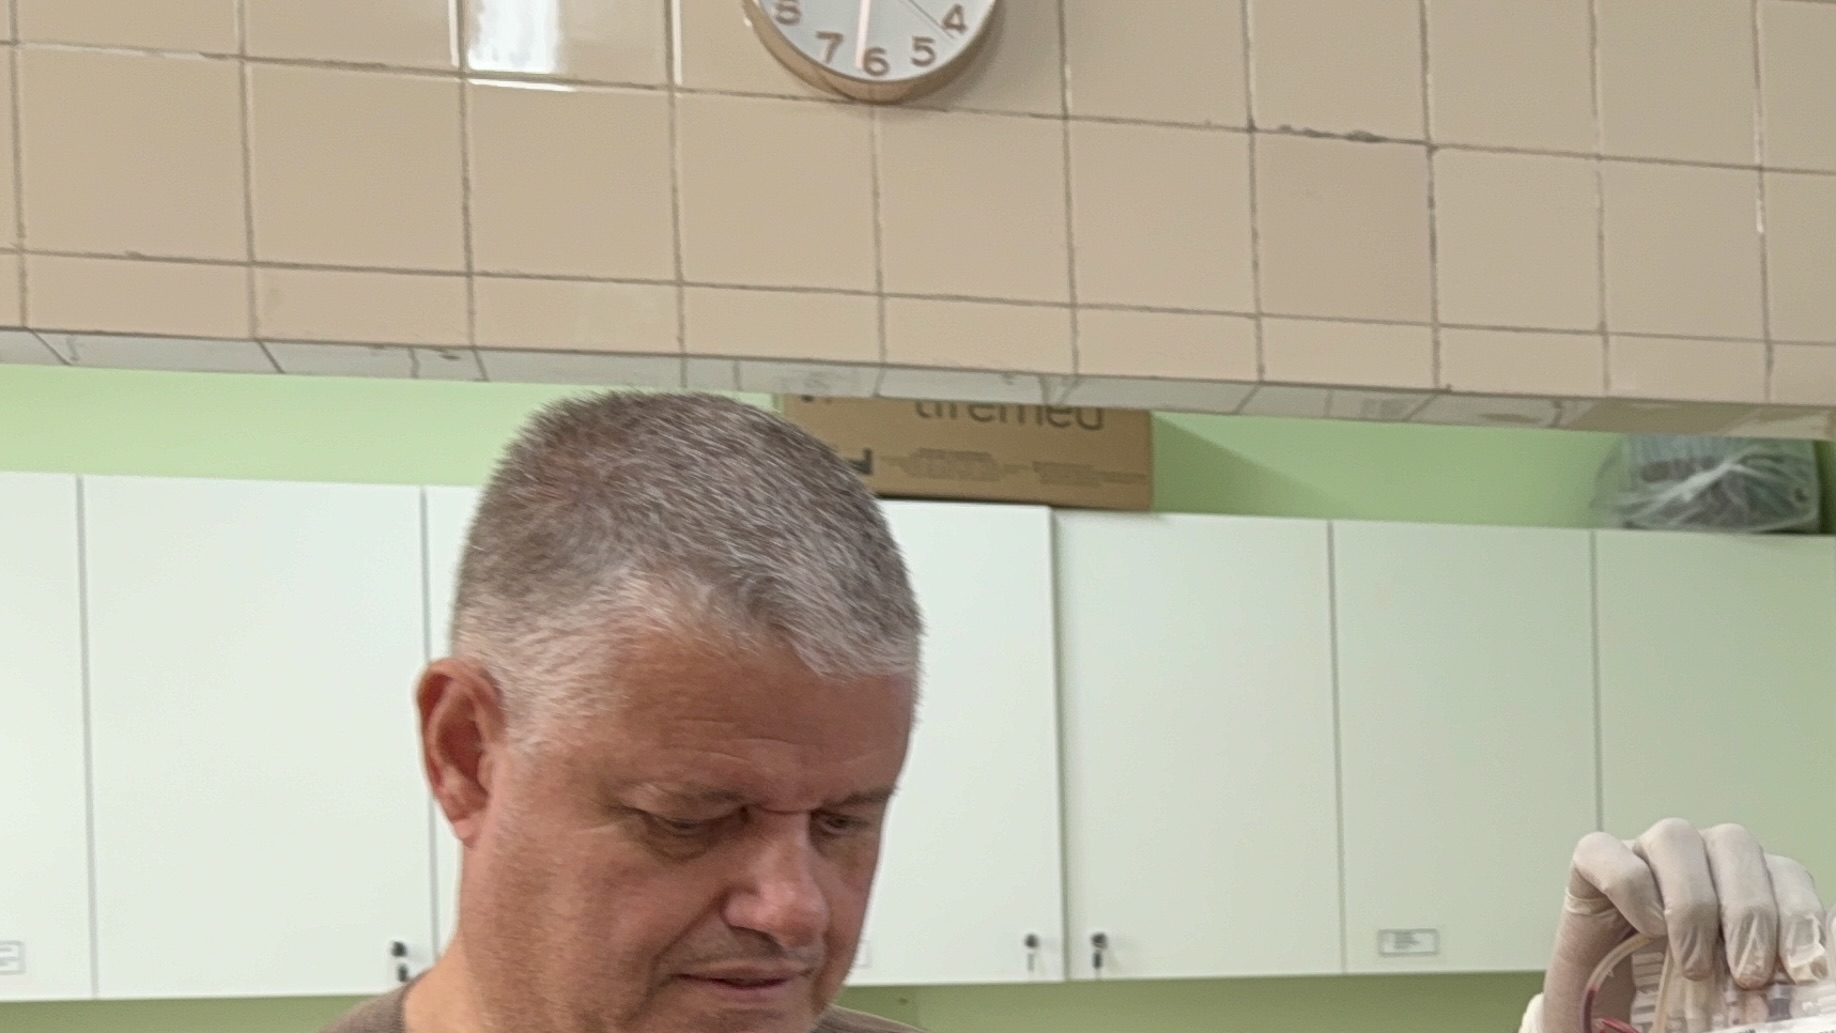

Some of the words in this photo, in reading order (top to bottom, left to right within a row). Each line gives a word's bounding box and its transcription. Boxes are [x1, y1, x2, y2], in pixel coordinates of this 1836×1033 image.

[942, 4, 968, 34] 4
[815, 30, 844, 64] 7
[862, 47, 890, 77] 6
[911, 36, 936, 67] 5
